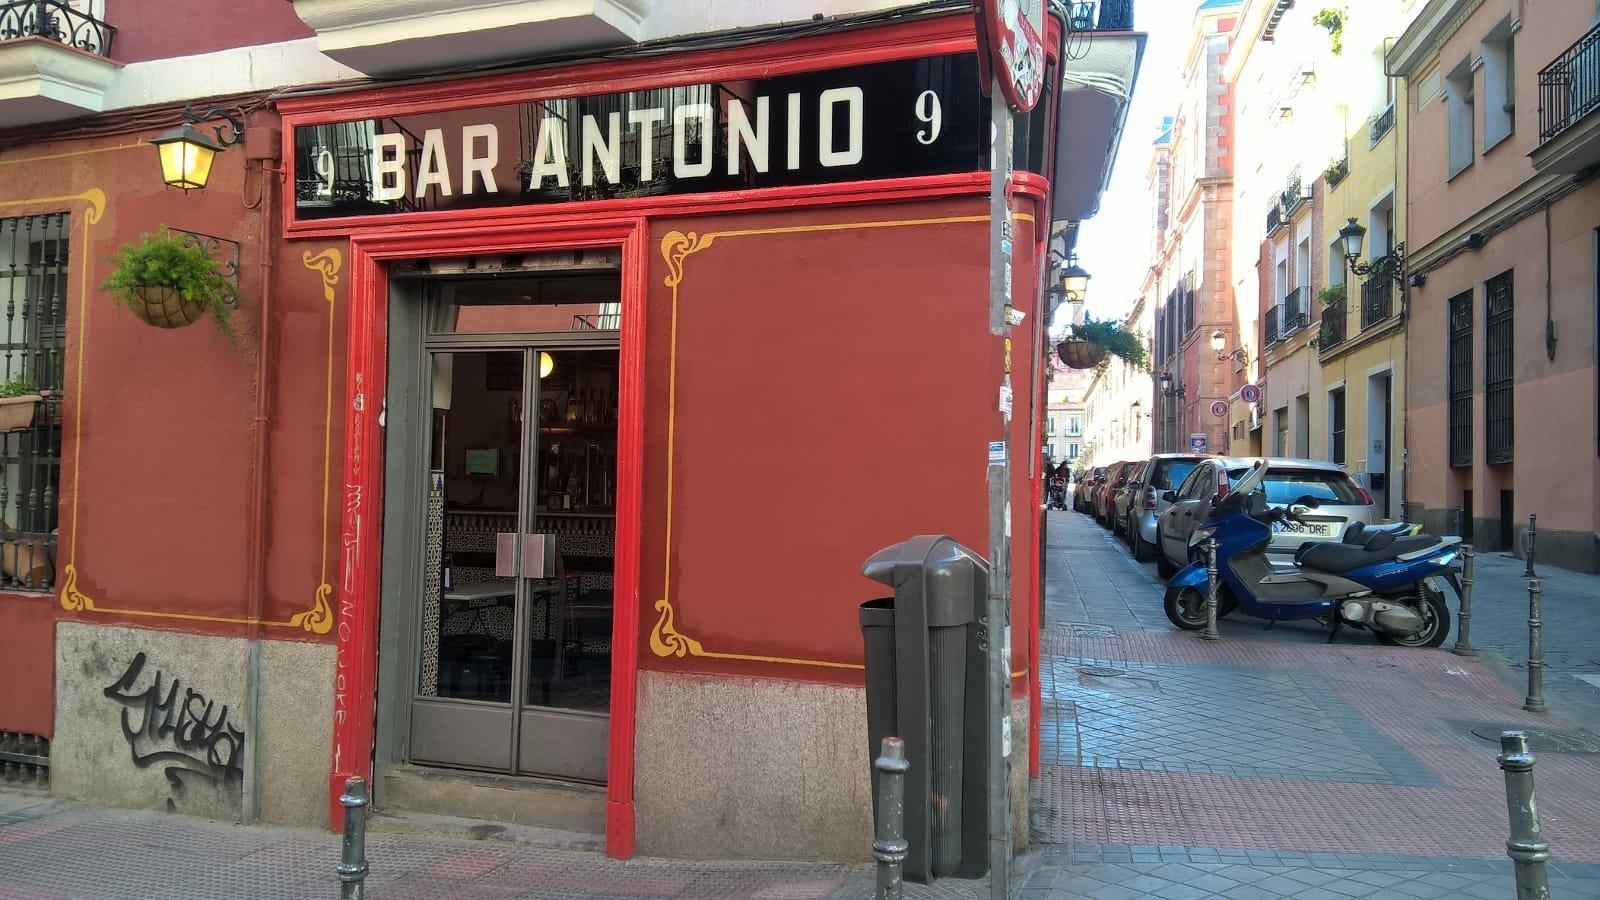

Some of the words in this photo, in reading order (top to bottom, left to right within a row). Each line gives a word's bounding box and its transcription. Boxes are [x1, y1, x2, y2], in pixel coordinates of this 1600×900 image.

[316, 150, 335, 196] 9
[372, 123, 499, 201] BAR
[529, 86, 864, 190] ANTONIO
[915, 89, 942, 145] 9
[1309, 524, 1328, 535] DRF
